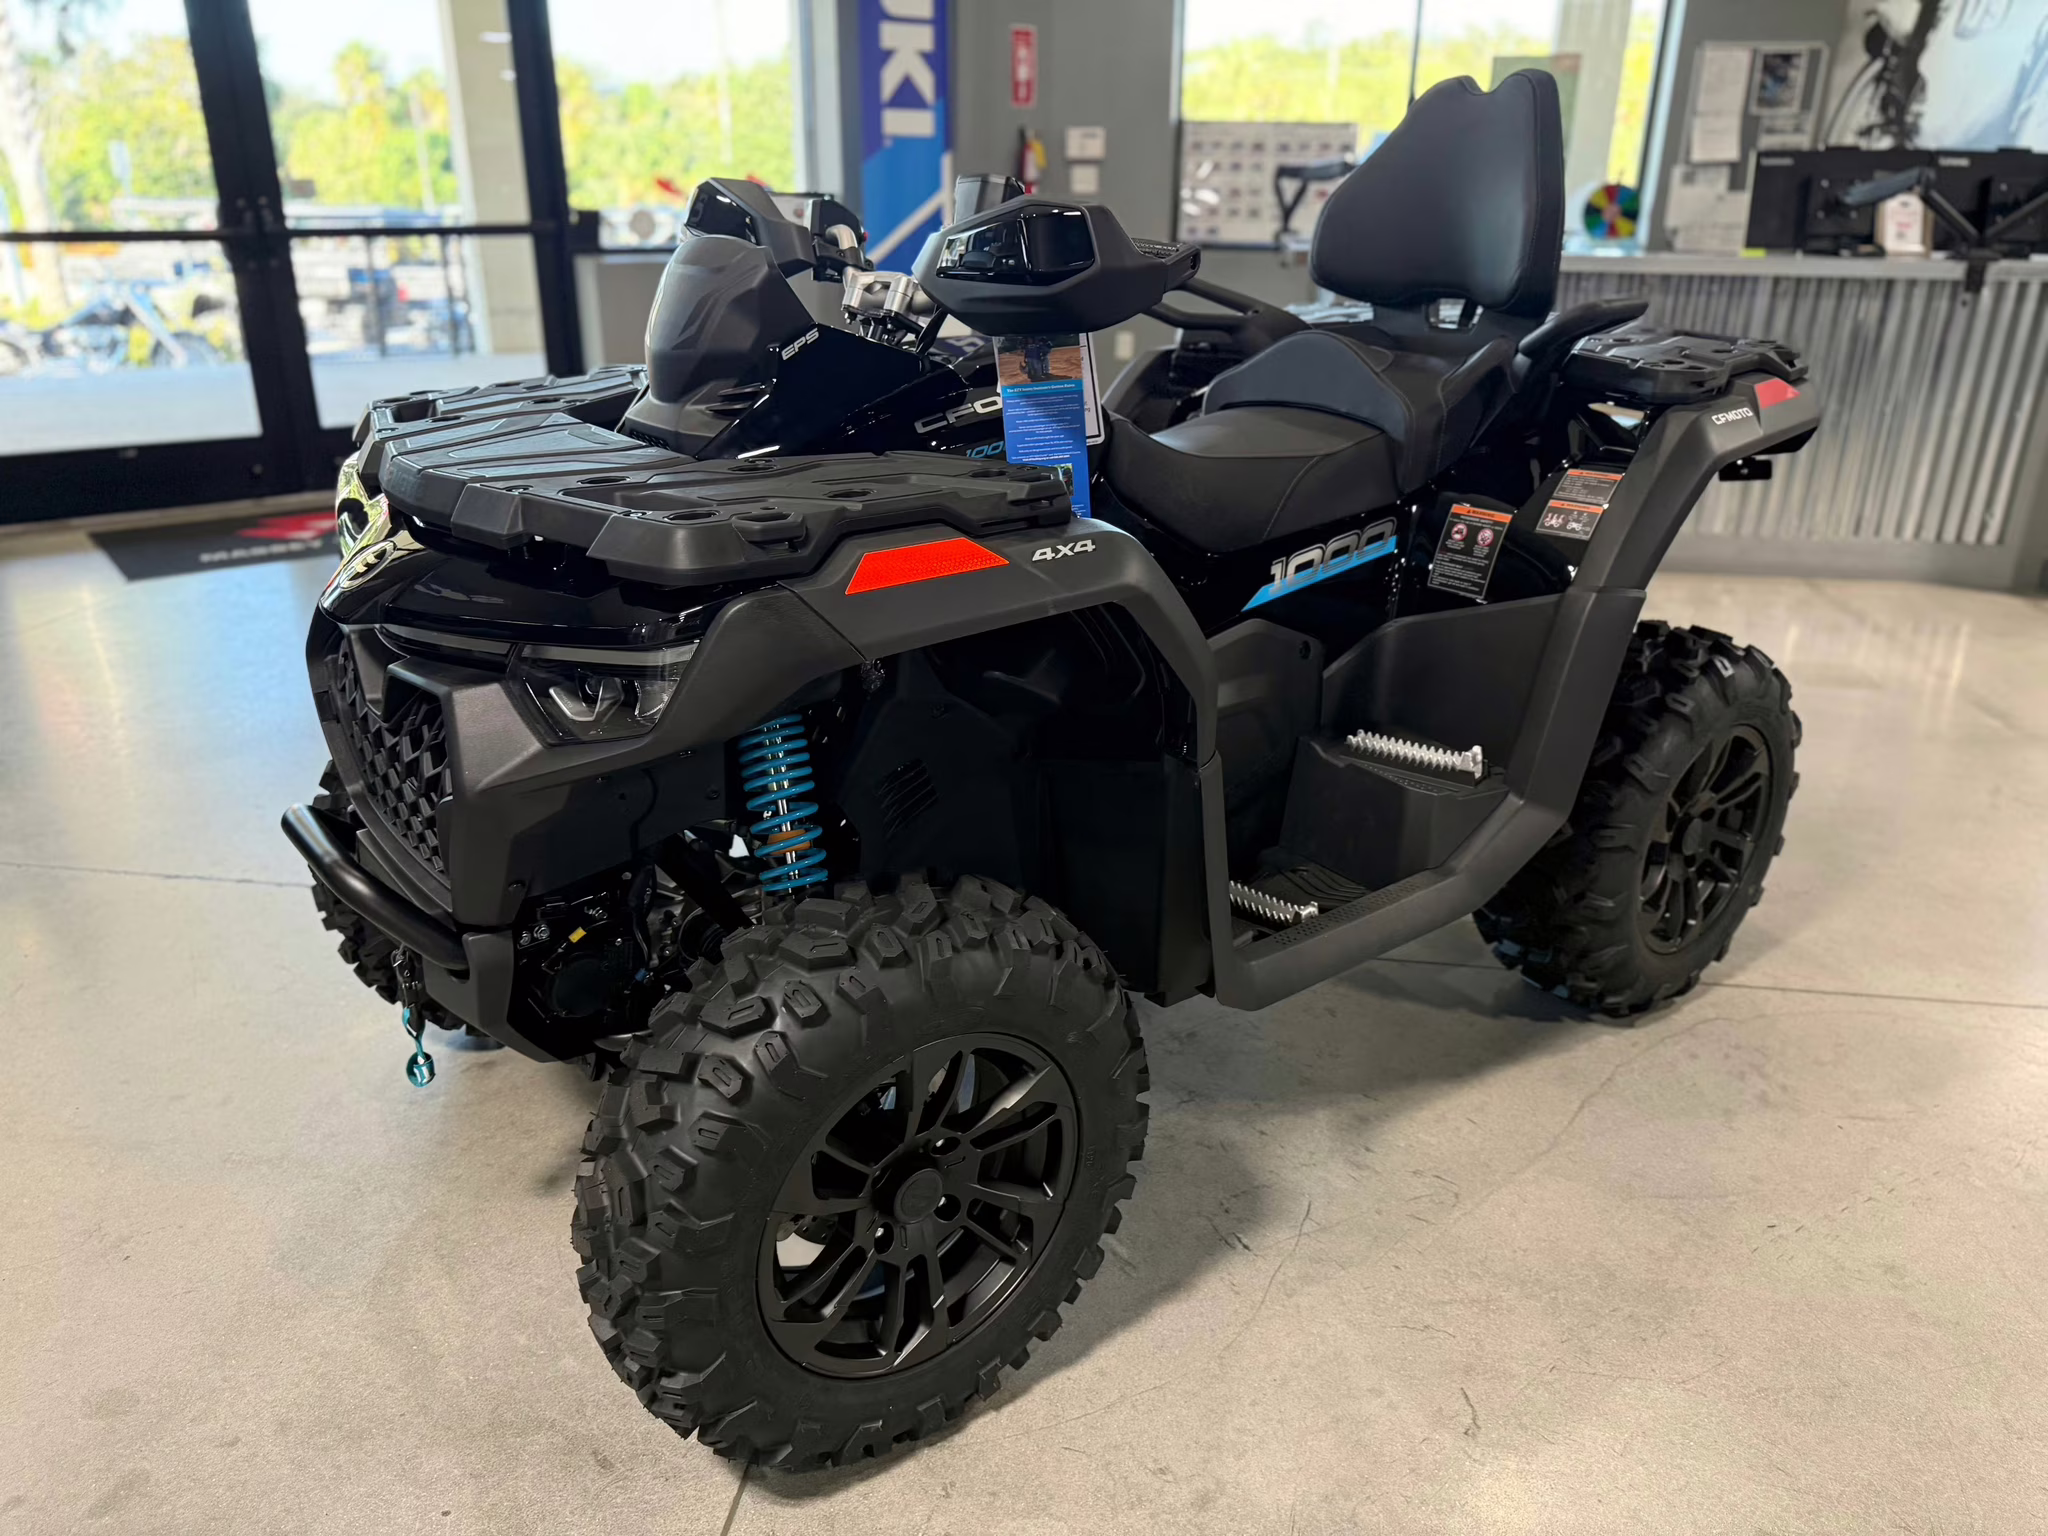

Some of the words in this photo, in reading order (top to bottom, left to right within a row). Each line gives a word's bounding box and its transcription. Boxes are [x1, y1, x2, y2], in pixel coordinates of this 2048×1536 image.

[879, 0, 935, 137] KI
[781, 327, 819, 360] EPS
[1711, 407, 1753, 425] CFMOTO
[1269, 516, 1397, 597] 1000
